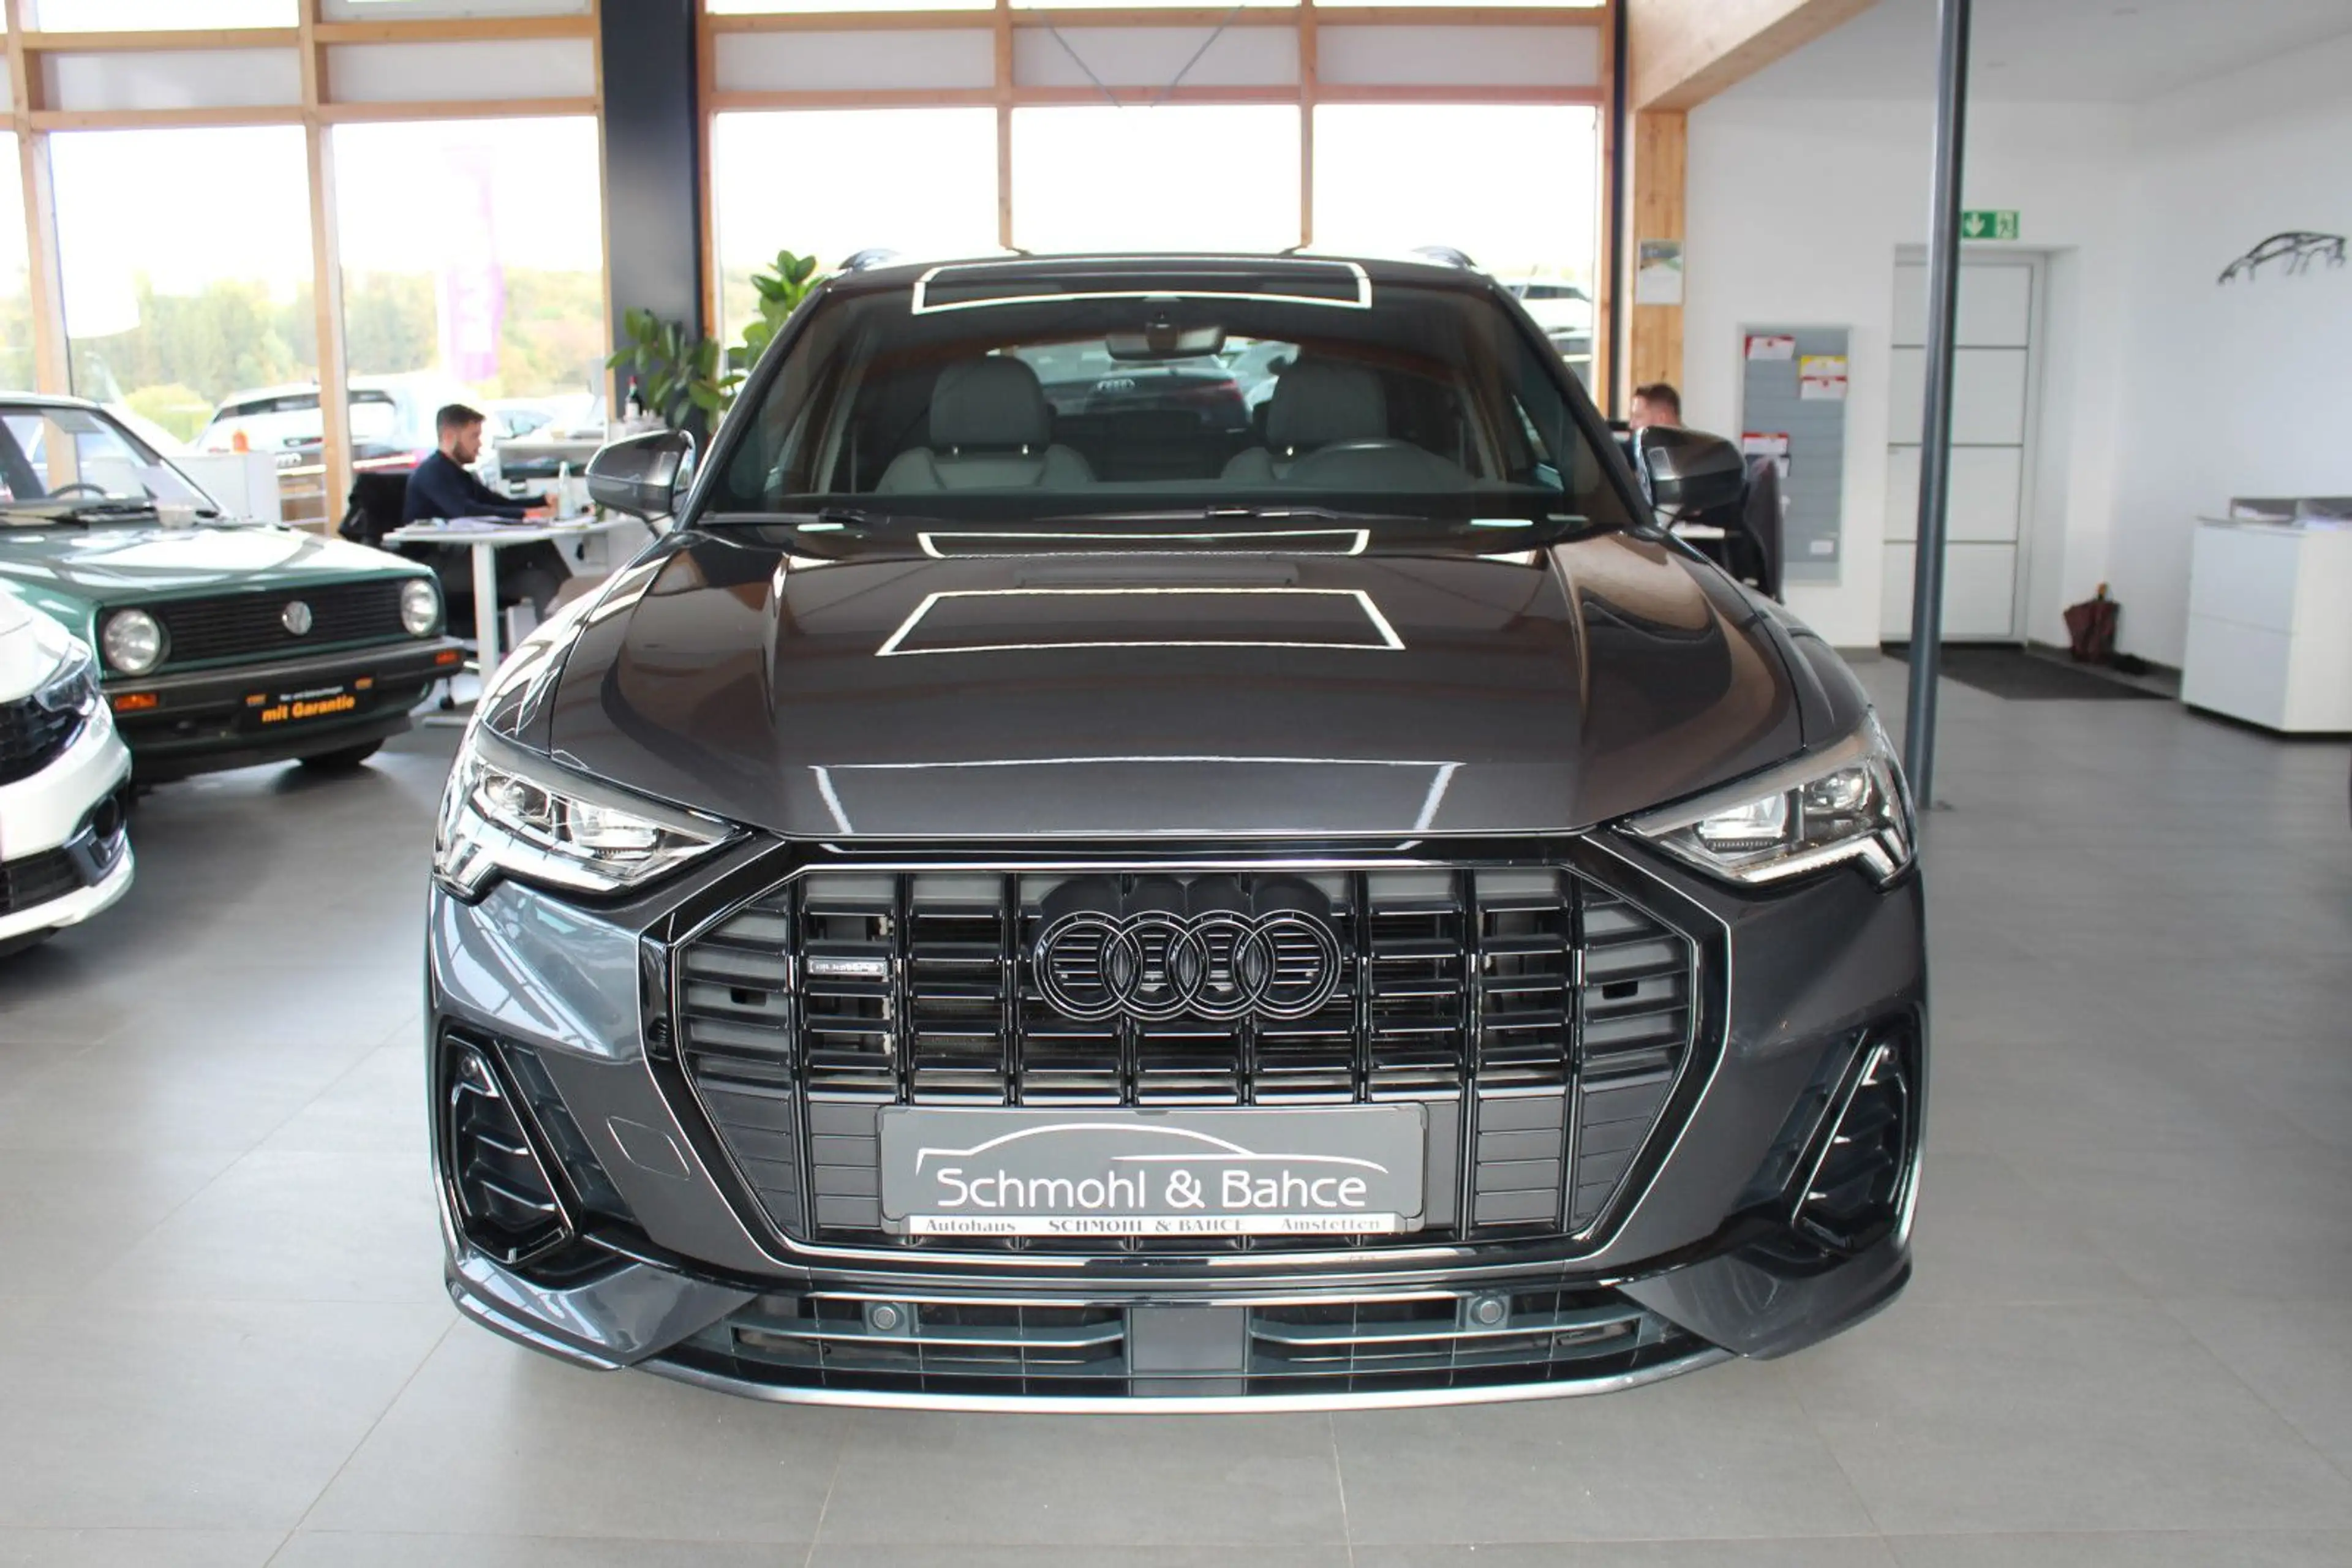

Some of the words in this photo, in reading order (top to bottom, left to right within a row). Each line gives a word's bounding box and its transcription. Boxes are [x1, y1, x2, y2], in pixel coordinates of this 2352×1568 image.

[262, 705, 288, 723] mit
[292, 694, 355, 718] Garantie
[937, 1167, 1146, 1208] Schmohl
[1165, 1169, 1205, 1208] &
[1221, 1169, 1367, 1208] Bahce
[926, 1218, 1016, 1232] Autohaus
[1049, 1219, 1142, 1232] SCHMOHL
[1155, 1219, 1170, 1232] &
[1178, 1218, 1246, 1231] BAHCE
[1281, 1217, 1381, 1231] Amstetten
